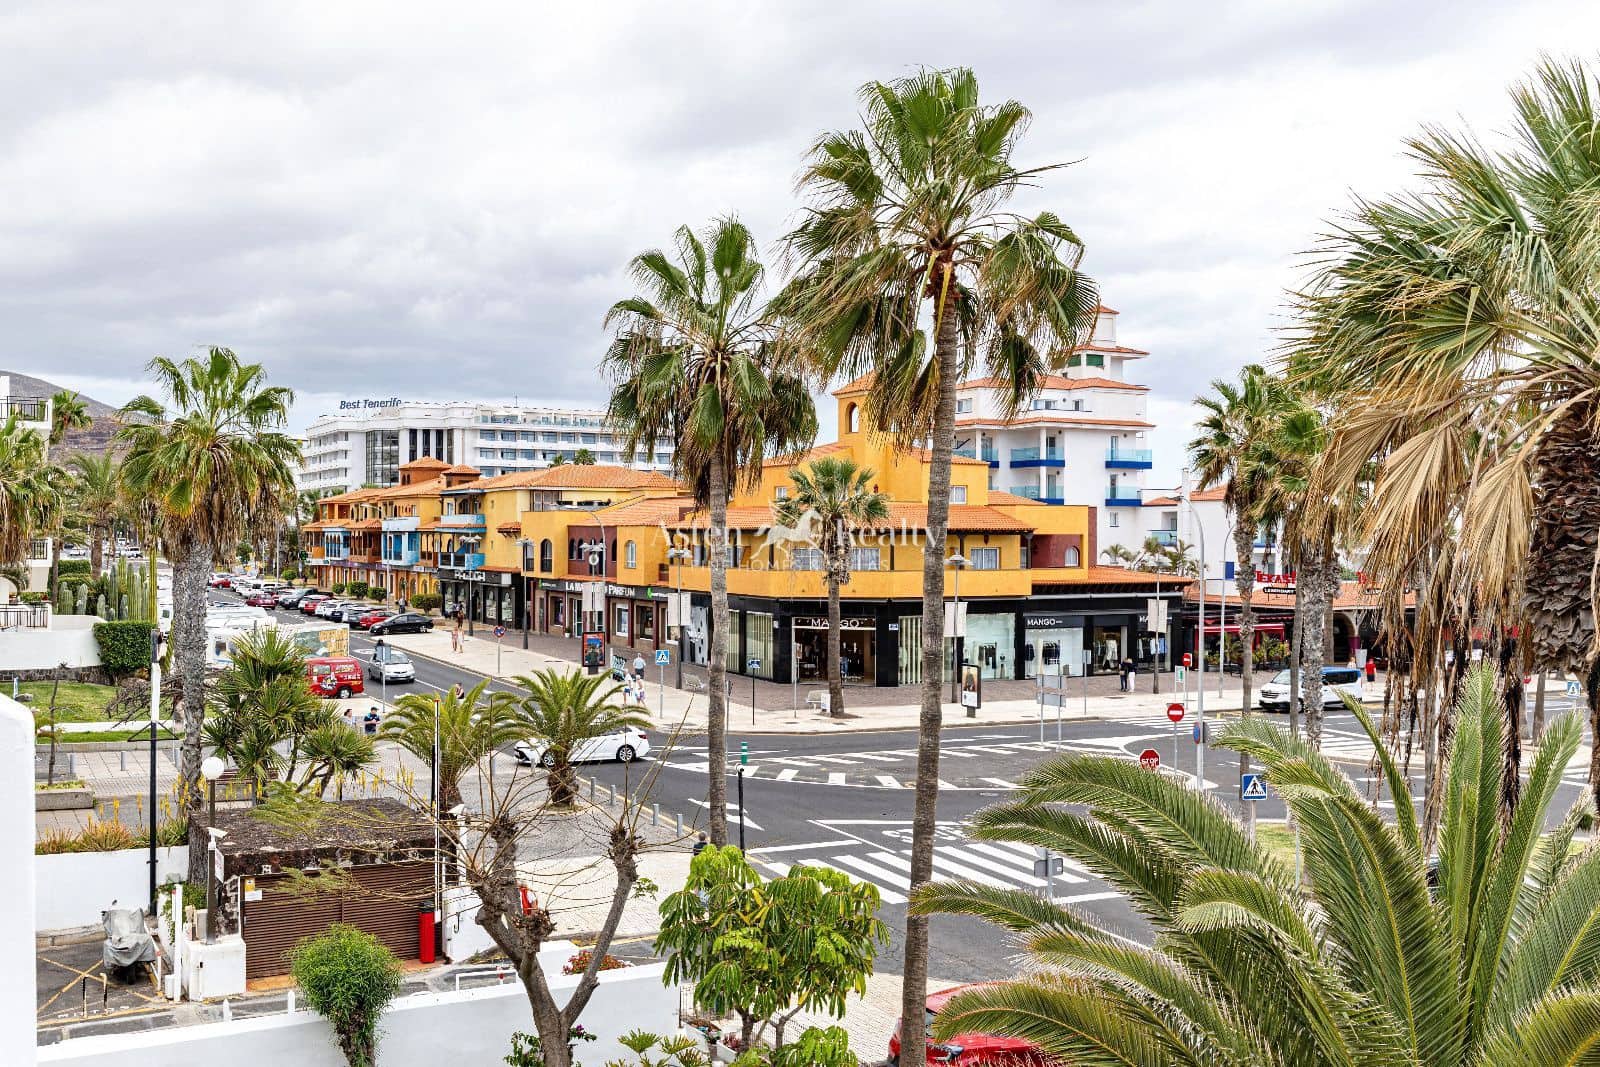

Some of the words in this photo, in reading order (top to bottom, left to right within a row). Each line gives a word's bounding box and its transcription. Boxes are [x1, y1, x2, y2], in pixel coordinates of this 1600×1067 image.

[340, 400, 360, 409] Best
[811, 618, 860, 628] MAGO
[1027, 617, 1055, 626] MANGO
